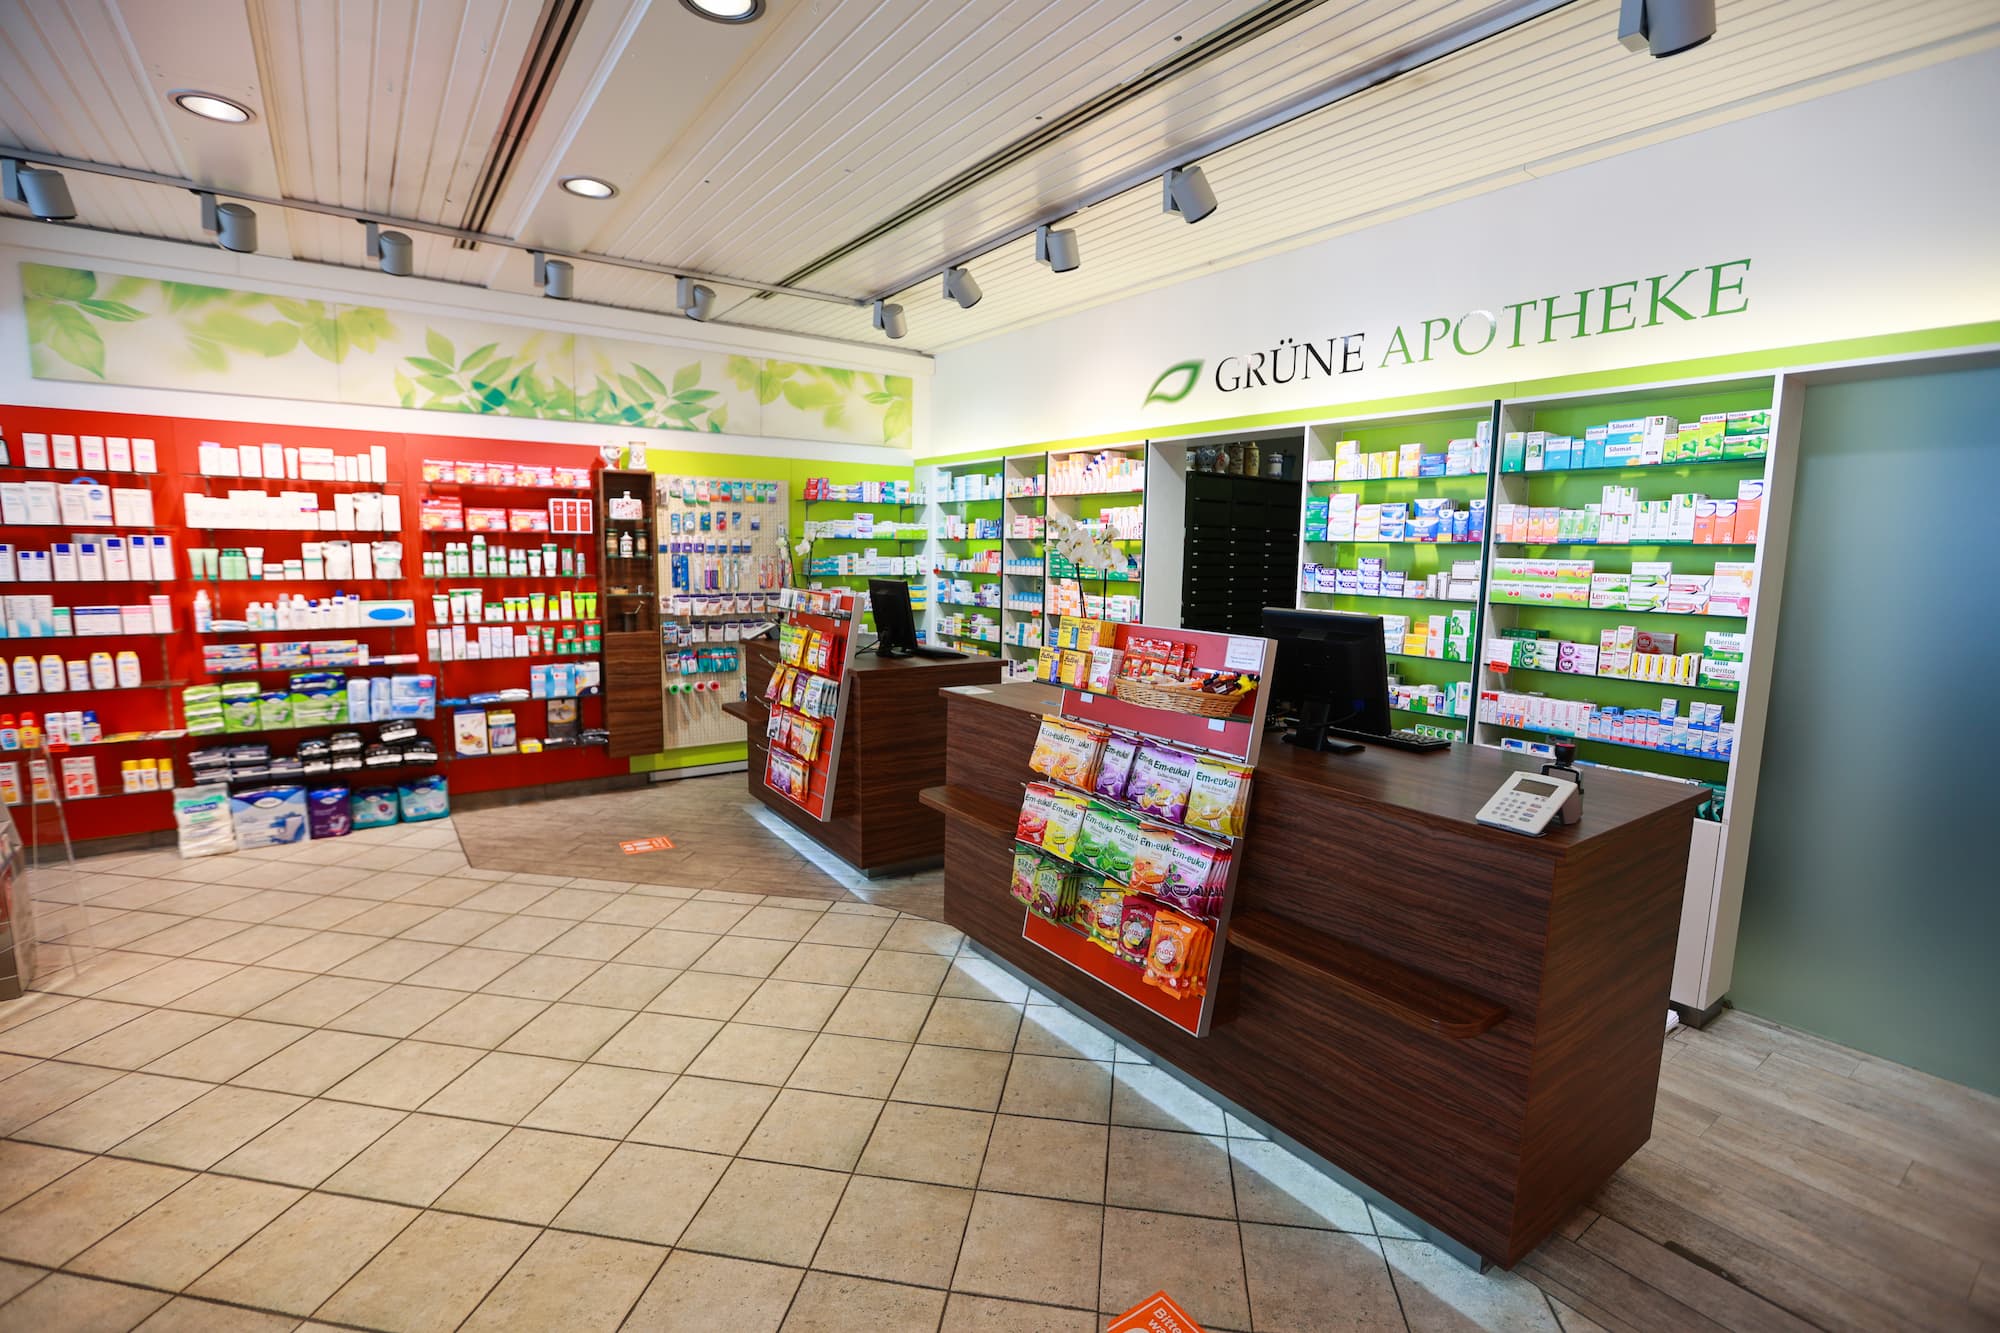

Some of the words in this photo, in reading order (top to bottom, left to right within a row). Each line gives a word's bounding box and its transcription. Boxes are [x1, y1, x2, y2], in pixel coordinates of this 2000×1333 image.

[1215, 332, 1365, 393] GRÜNE
[1378, 258, 1752, 369] APOTHEKE
[1153, 760, 1191, 778] Em-eukal
[1196, 771, 1237, 789] Em-eukal
[1172, 847, 1208, 870] Em-eukal
[1153, 1307, 1182, 1333] Bitte
